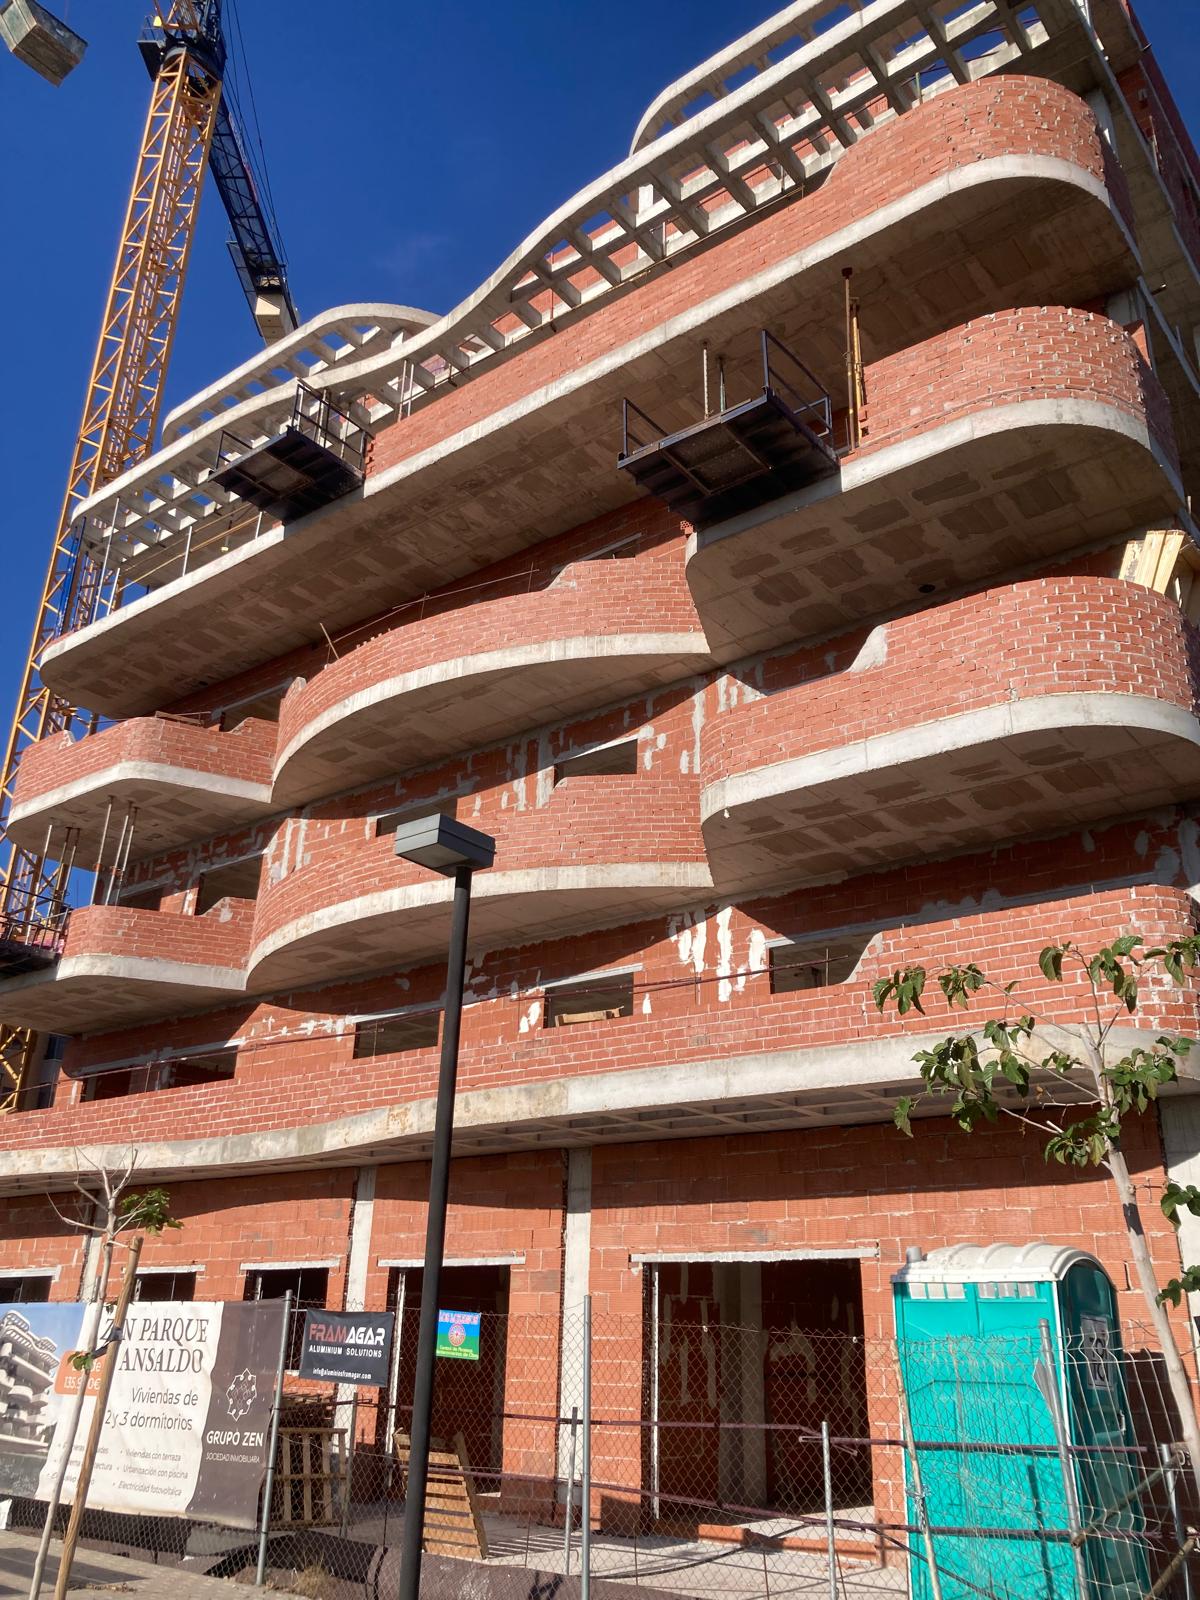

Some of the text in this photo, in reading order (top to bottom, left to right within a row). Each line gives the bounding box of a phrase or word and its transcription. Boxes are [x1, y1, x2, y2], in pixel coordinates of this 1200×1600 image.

[99, 1318, 209, 1346] ZN PARQUE
[309, 1323, 386, 1346] FRAMAGAR
[118, 1347, 204, 1374] ANSALDO
[309, 1344, 382, 1358] ALUMINIUM SOLUTIONS
[132, 1387, 198, 1406] Viviendas de
[119, 1411, 129, 1426] 3
[130, 1412, 193, 1431] dormitorios
[206, 1430, 264, 1447] GRUPO ZEN
[152, 1451, 161, 1460] con
[157, 1468, 168, 1478] con
